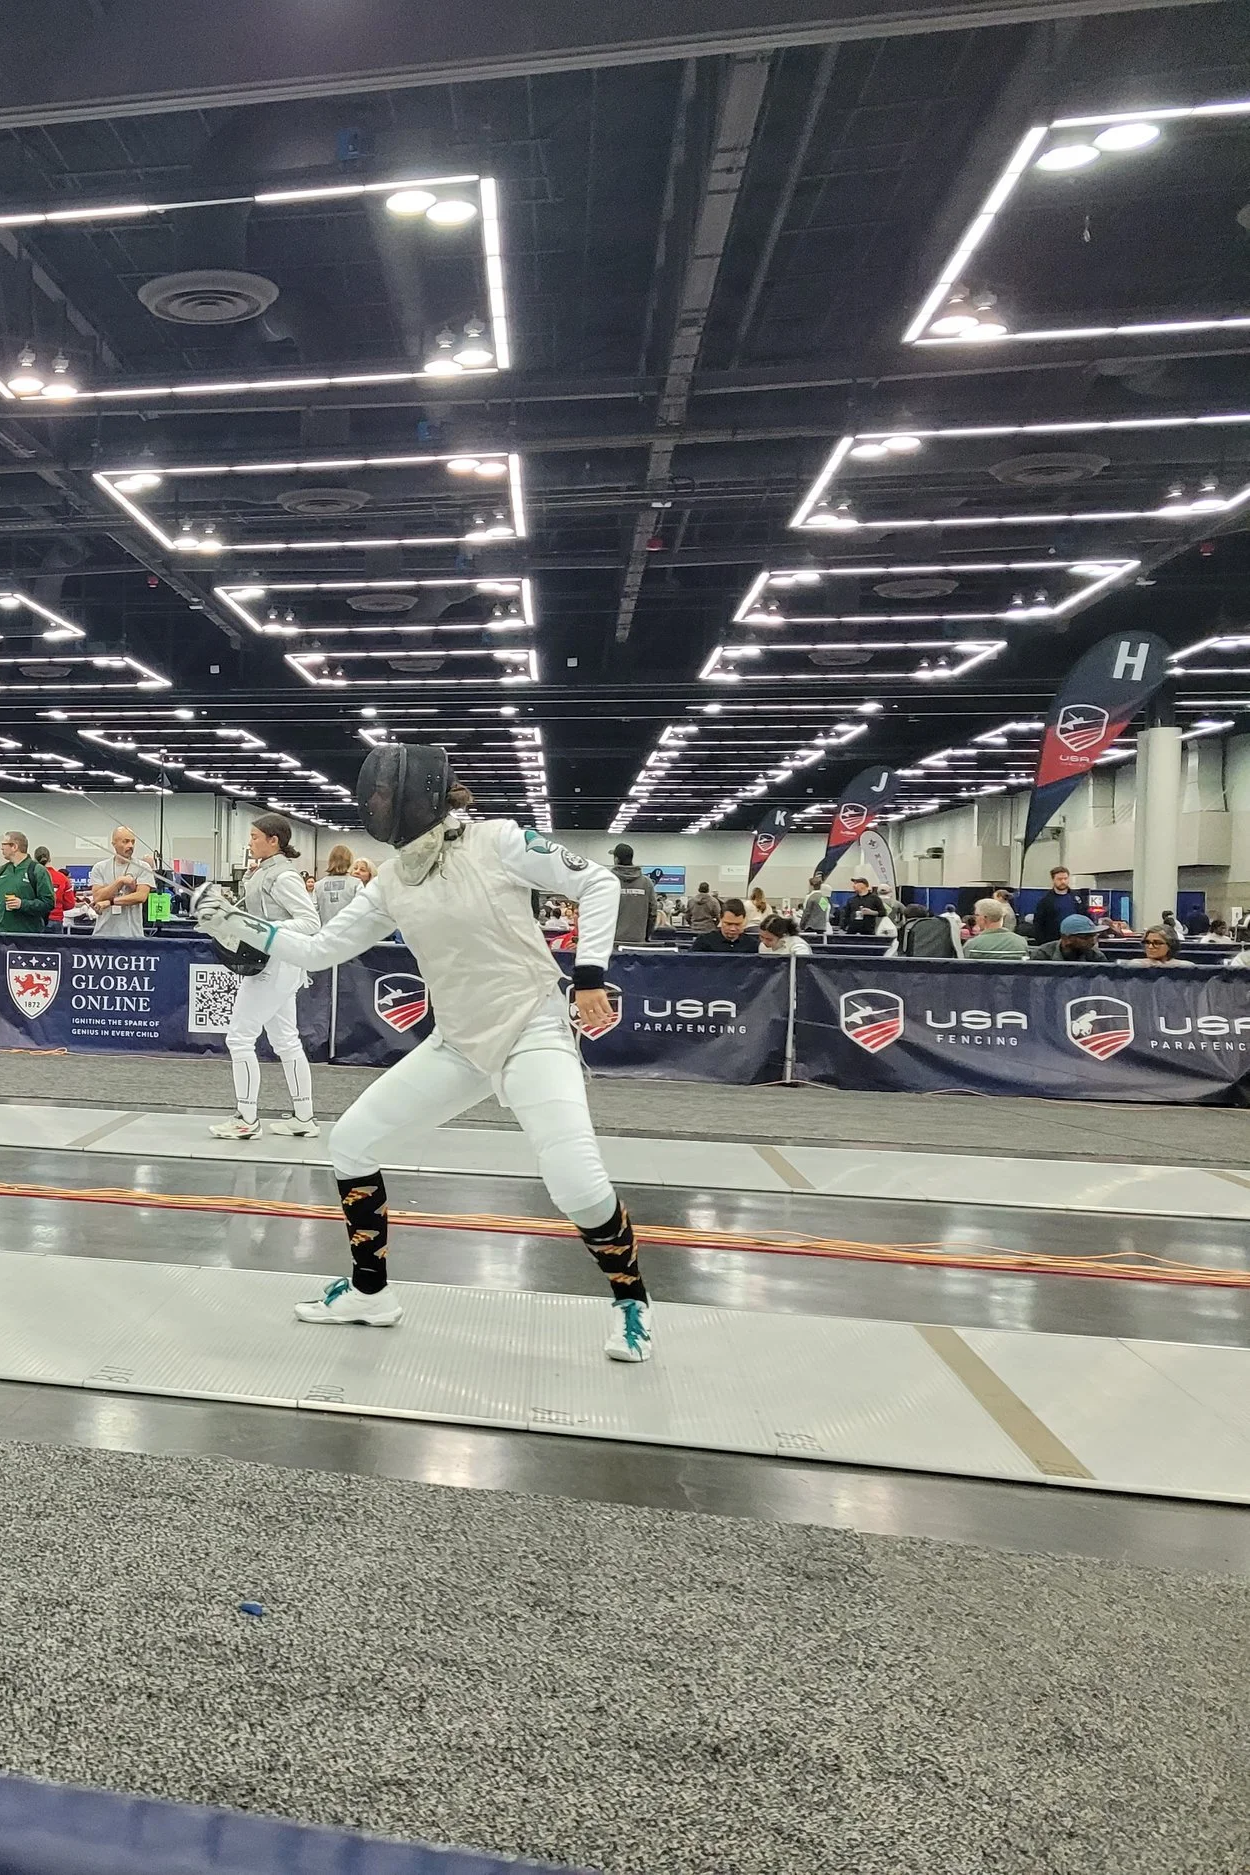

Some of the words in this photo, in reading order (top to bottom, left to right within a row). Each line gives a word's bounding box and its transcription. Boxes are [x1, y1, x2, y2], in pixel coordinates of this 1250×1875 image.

[1112, 641, 1150, 681] H
[1059, 754, 1090, 763] USA
[870, 772, 889, 793] J
[774, 810, 788, 827] K
[71, 953, 160, 972] DWIGHT
[71, 974, 156, 992] GLOBAL
[24, 1001, 41, 1009] 1872
[71, 994, 151, 1012] ONLINE
[643, 998, 737, 1019] USA
[71, 1017, 106, 1025] IGNITING
[108, 1018, 122, 1026] THE
[124, 1019, 148, 1027] SPARK
[148, 1020, 160, 1028] OF
[925, 1009, 1028, 1030] USA
[71, 1028, 99, 1036] GENIUS
[100, 1029, 110, 1037] IN
[111, 1029, 135, 1037] EVERY
[135, 1030, 160, 1039] CHILD
[633, 1022, 748, 1035] PARAFENCING
[936, 1033, 1019, 1047] FENCING
[1150, 1040, 1247, 1052] PARAFENC
